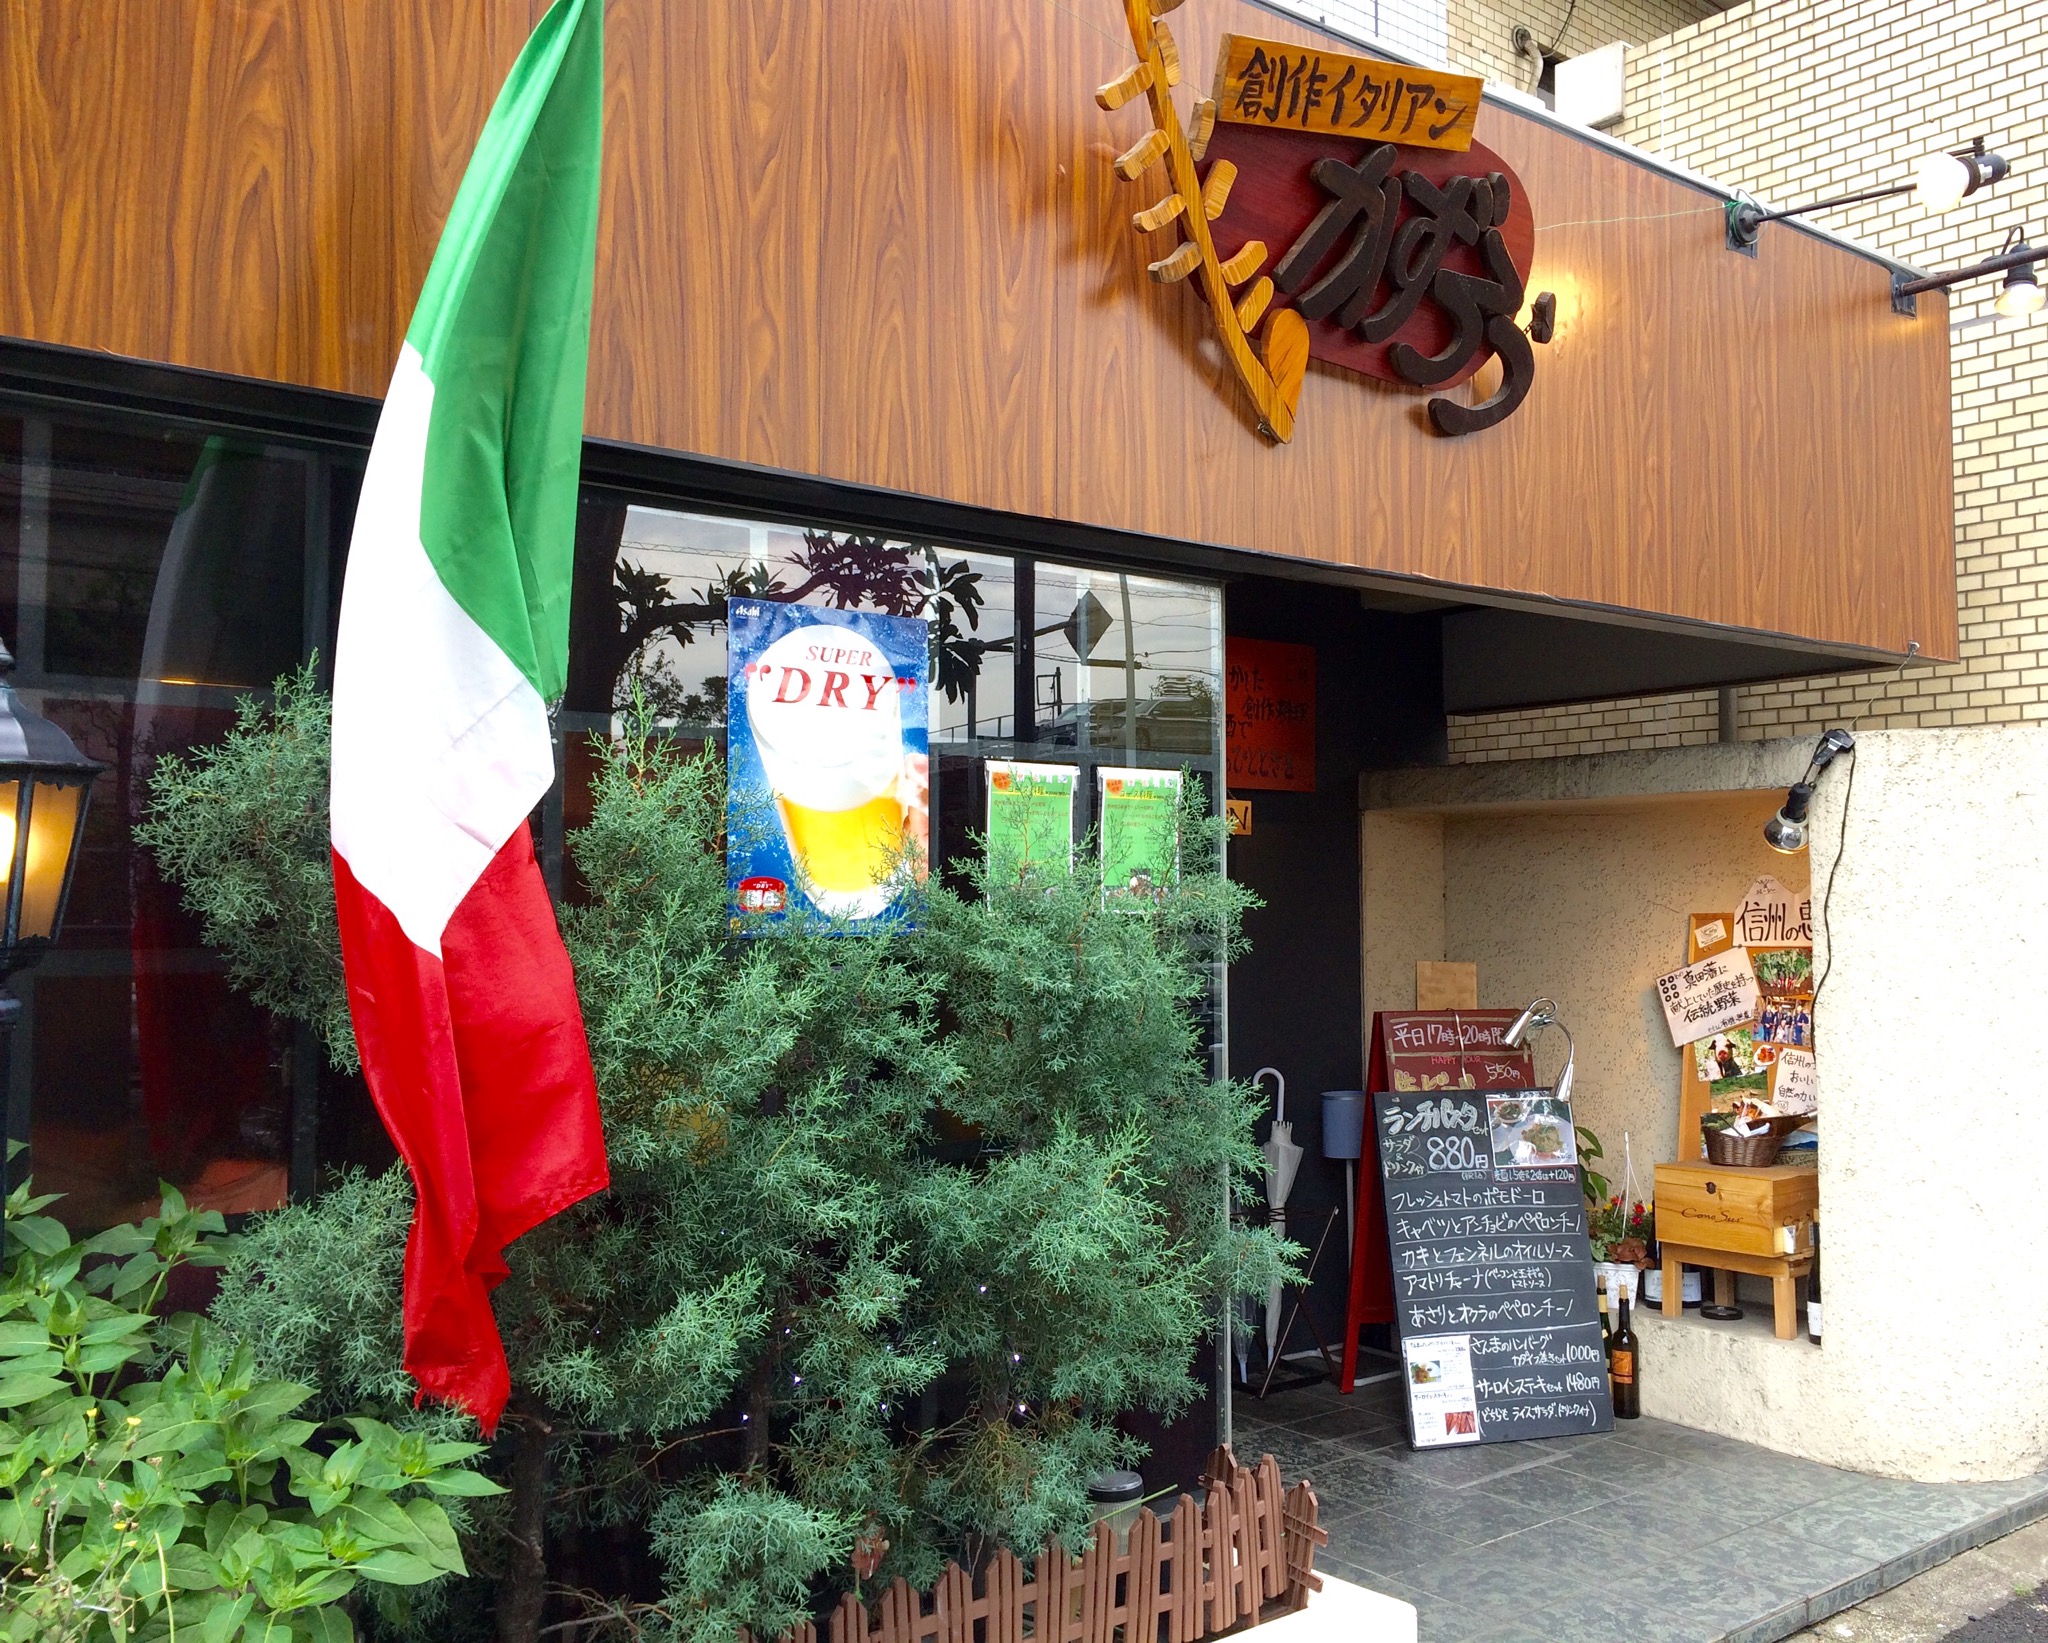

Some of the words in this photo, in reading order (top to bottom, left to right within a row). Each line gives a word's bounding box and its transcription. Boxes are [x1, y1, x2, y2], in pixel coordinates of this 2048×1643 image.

[1234, 46, 1468, 140] 創作イタリアン
[736, 604, 760, 617] Asahi
[806, 645, 872, 666] SUPER
[1683, 991, 1742, 1023] 伝統野菜
[1431, 1056, 1456, 1065] HAPPY
[1383, 1135, 1415, 1154] サラダ
[1427, 1136, 1488, 1170] 880円
[1396, 1153, 1404, 1161] &
[1392, 1187, 1545, 1211] フレッシュトマトのポモドーロ
[1681, 1207, 1716, 1219] Cono
[1715, 1210, 1743, 1223] Sur
[1396, 1212, 1581, 1240] キャベツとアンチョビのペペロンチーノ
[1401, 1240, 1574, 1269] カキとフェンネルのオイルソース
[1408, 1298, 1574, 1327] あさりとオクラのペペロンチーノ
[1470, 1333, 1553, 1355] さんまのハンバーグ
[1566, 1342, 1600, 1362] 1000円
[1566, 1372, 1600, 1392] 1480円
